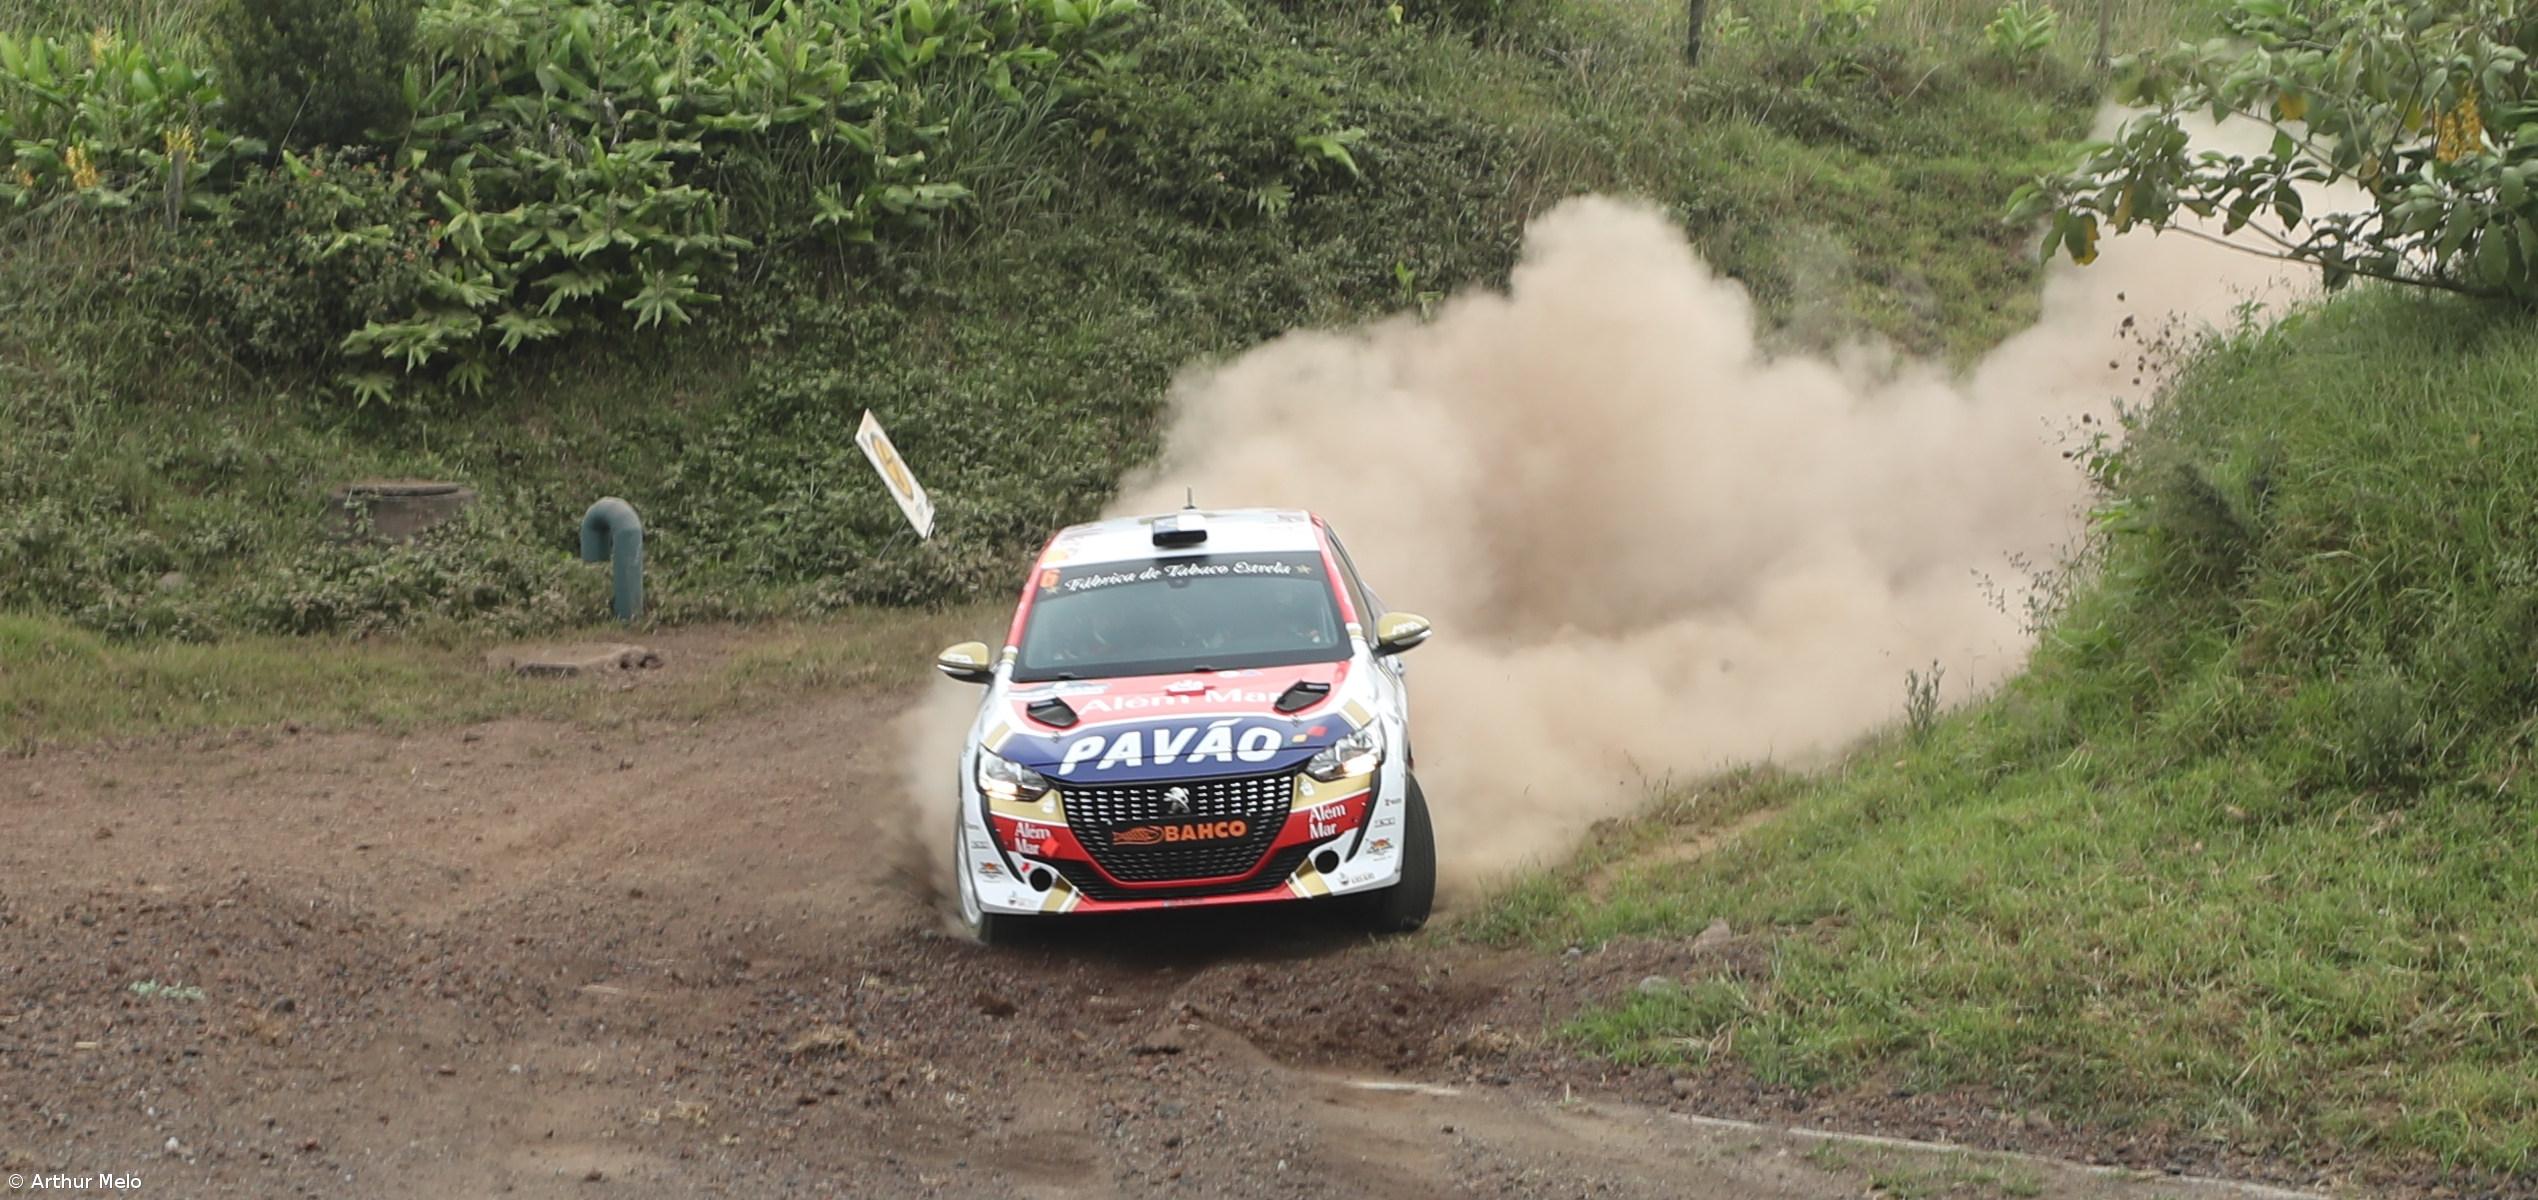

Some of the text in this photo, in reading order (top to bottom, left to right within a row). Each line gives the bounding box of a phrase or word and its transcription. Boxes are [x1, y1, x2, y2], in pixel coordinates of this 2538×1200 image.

[1139, 566, 1162, 581] de
[1164, 562, 1229, 577] Tabaco
[1058, 718, 1283, 776] PAVÃO
[1309, 804, 1347, 823] Além
[1014, 822, 1052, 840] Além
[1164, 820, 1247, 842] BAHCO
[1310, 821, 1337, 840] Mar
[1014, 837, 1041, 855] Mar
